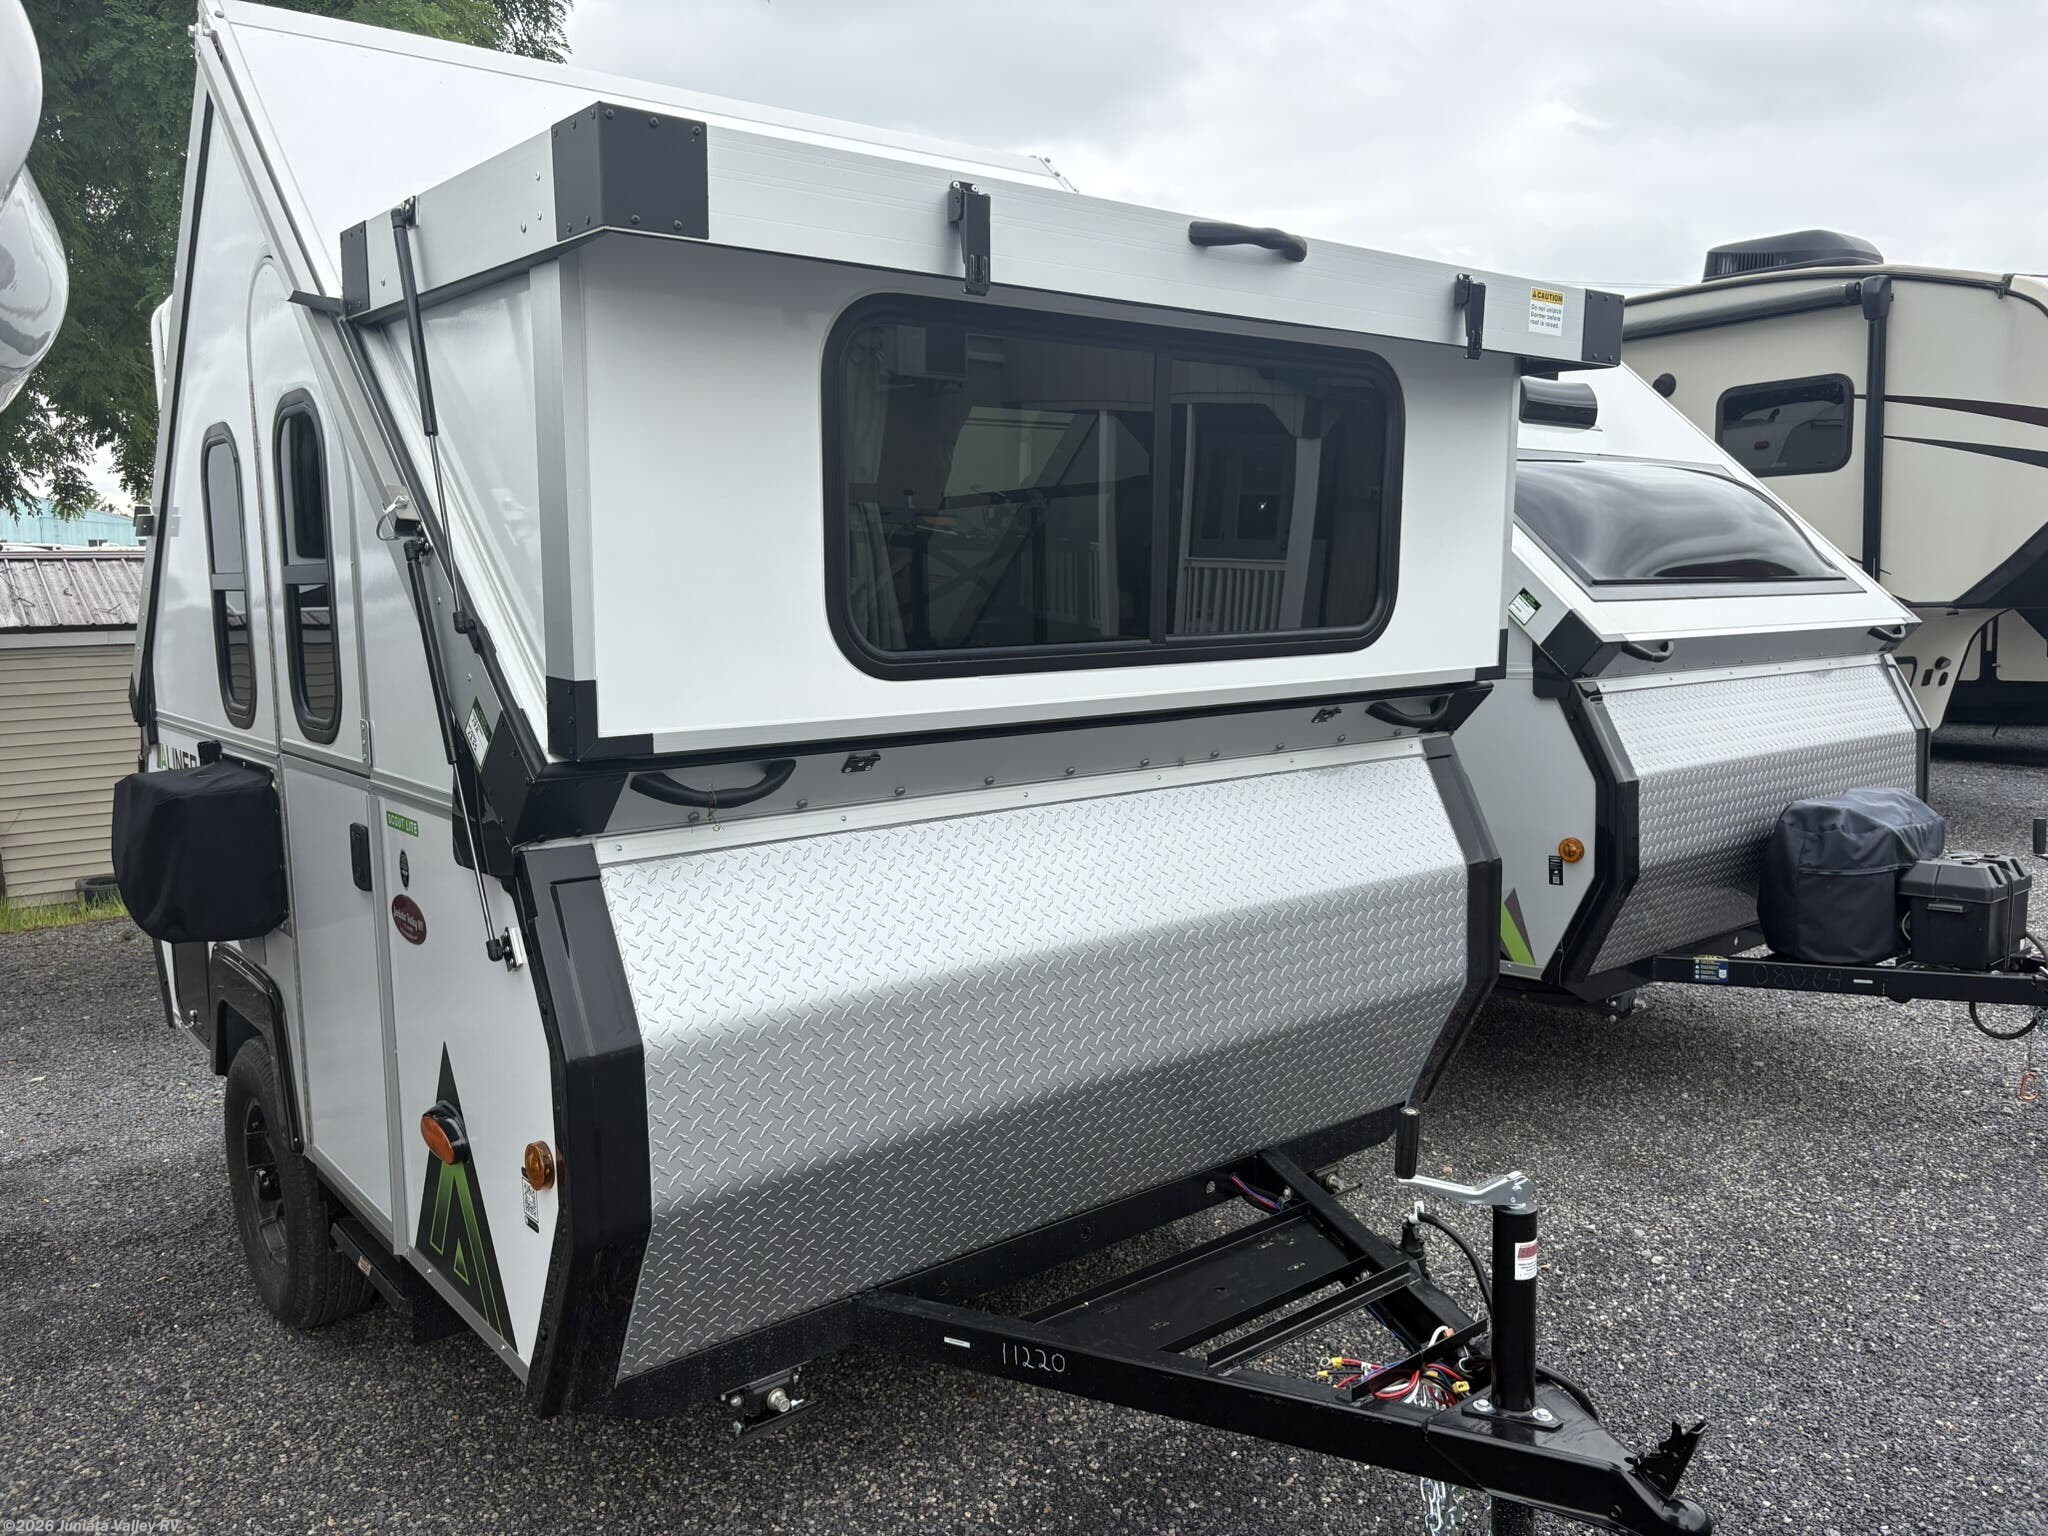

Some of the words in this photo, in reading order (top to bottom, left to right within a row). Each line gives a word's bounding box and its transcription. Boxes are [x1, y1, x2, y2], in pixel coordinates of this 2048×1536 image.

[1537, 291, 1563, 302] CAUTION
[387, 812, 405, 829] SCOUT
[405, 819, 418, 835] LITE
[1003, 1342, 1066, 1372] 11220
